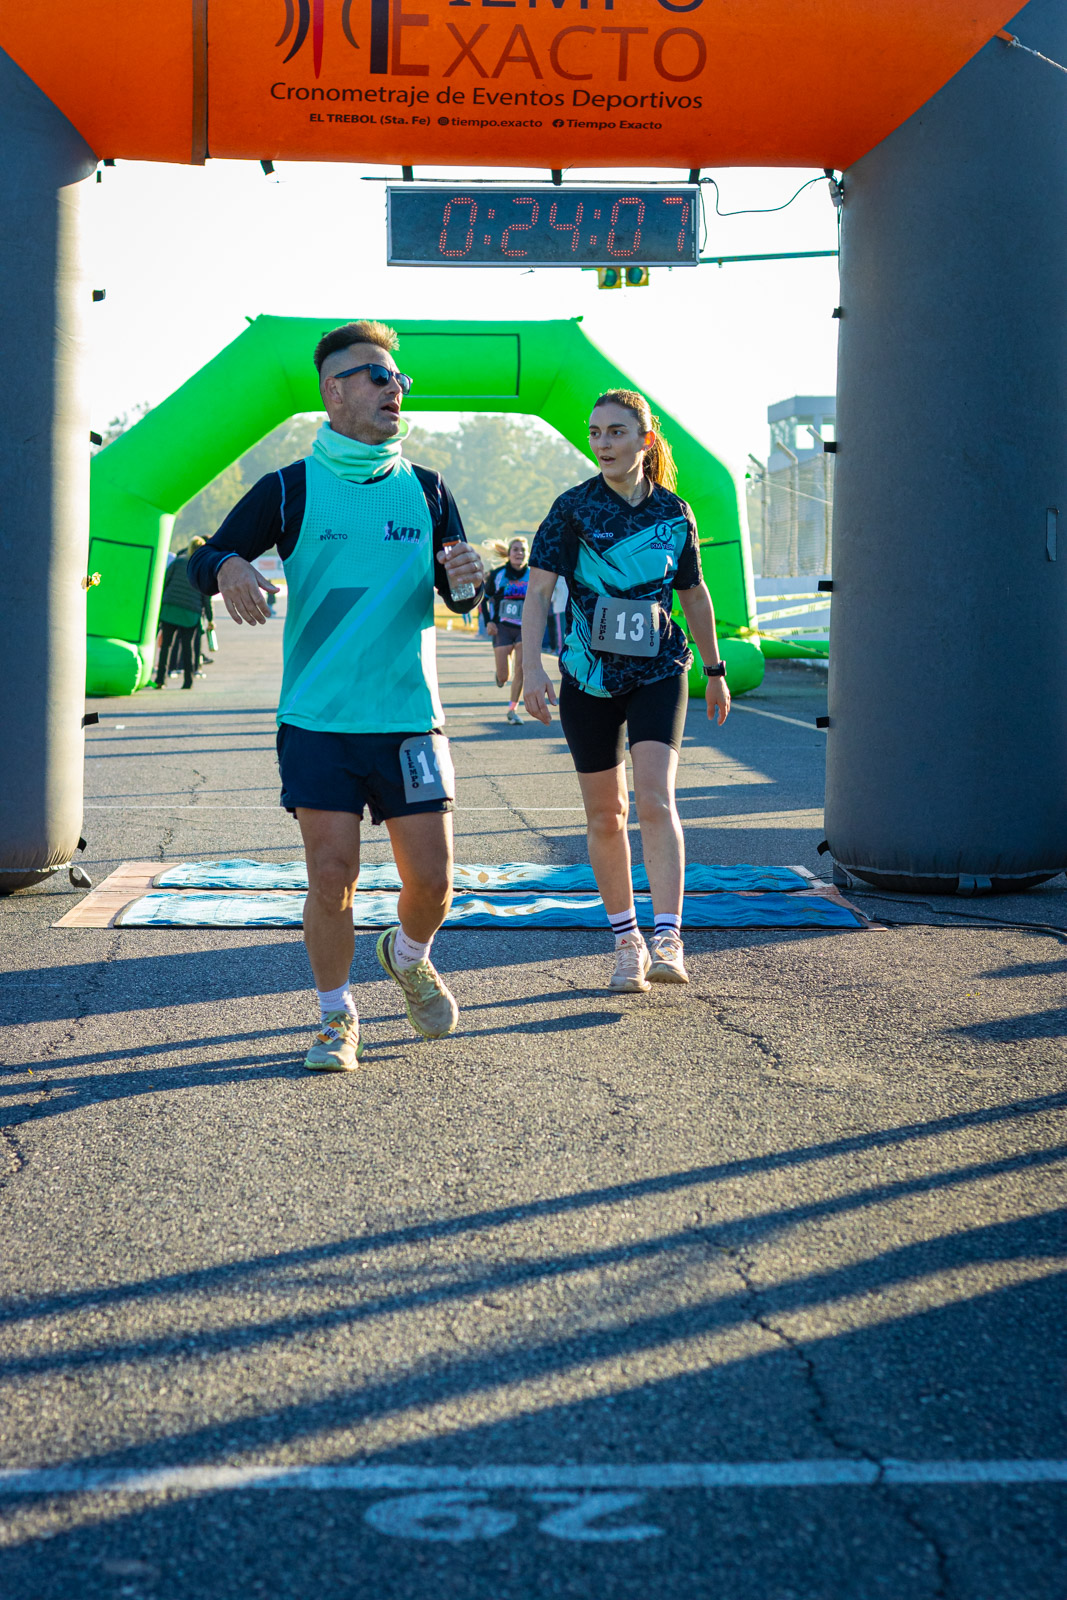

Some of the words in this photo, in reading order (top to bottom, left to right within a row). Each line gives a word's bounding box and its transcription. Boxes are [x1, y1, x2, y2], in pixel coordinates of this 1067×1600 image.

[391, 0, 708, 83] EXACTO
[270, 82, 430, 108] Cronometraje
[436, 86, 465, 105] de
[473, 87, 565, 106] Eventos
[572, 89, 703, 111] Deportivos
[309, 113, 325, 123] EL
[326, 114, 377, 124] TREBOL
[380, 115, 409, 126] (Sta.
[412, 116, 431, 127] Fe)
[451, 117, 543, 129] tiempo.exacto
[566, 119, 616, 131] Tiempo
[619, 120, 663, 130] Exacto
[615, 611, 646, 642] 13
[404, 749, 419, 789] TIEMPO
